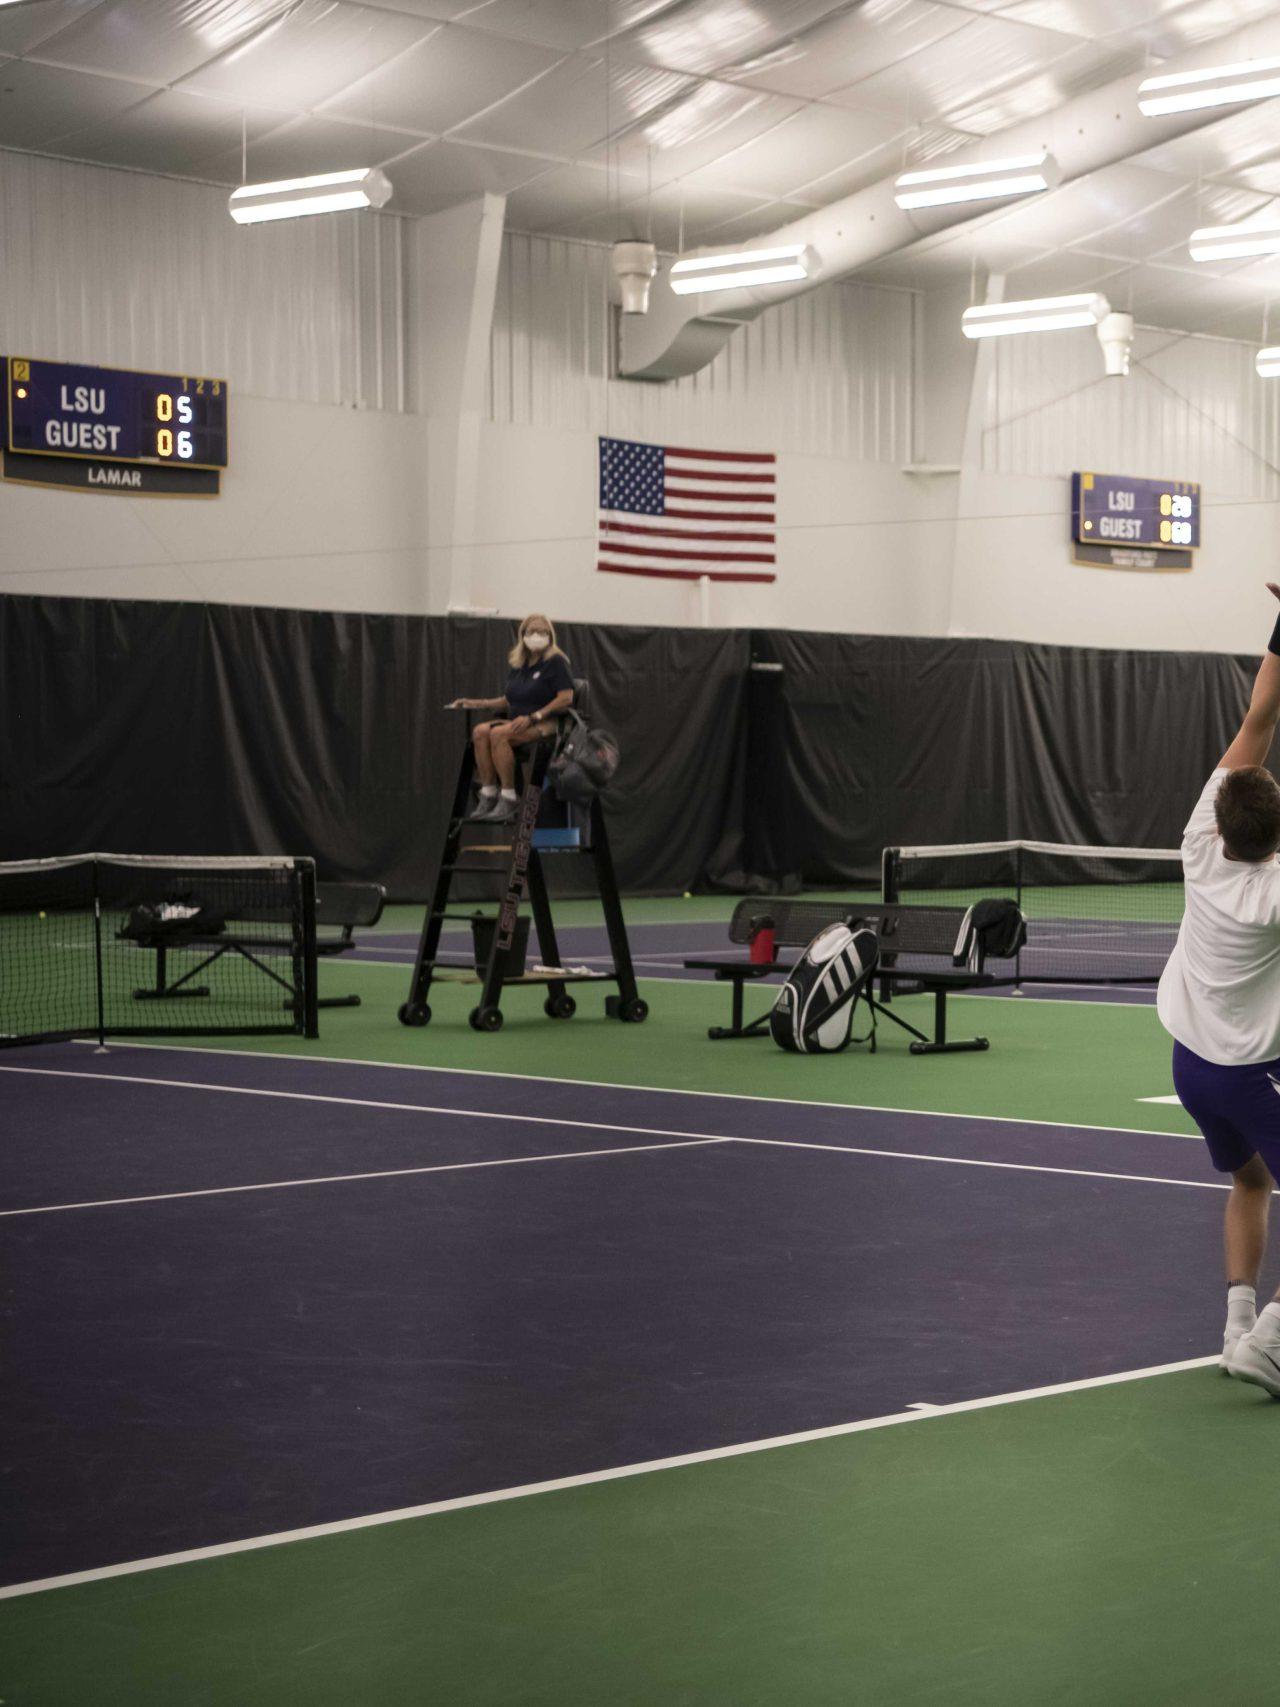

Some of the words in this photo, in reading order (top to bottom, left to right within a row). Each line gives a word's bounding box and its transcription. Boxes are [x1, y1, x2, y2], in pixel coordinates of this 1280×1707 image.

[16, 364, 26, 378] 2
[196, 380, 204, 394] 2
[212, 381, 220, 396] 3
[61, 385, 105, 414] LSU
[45, 419, 121, 451] GUEST
[88, 468, 141, 487] LAMAR
[1108, 491, 1135, 512] LSU
[1099, 516, 1142, 539] GUEST
[496, 893, 519, 951] LSU
